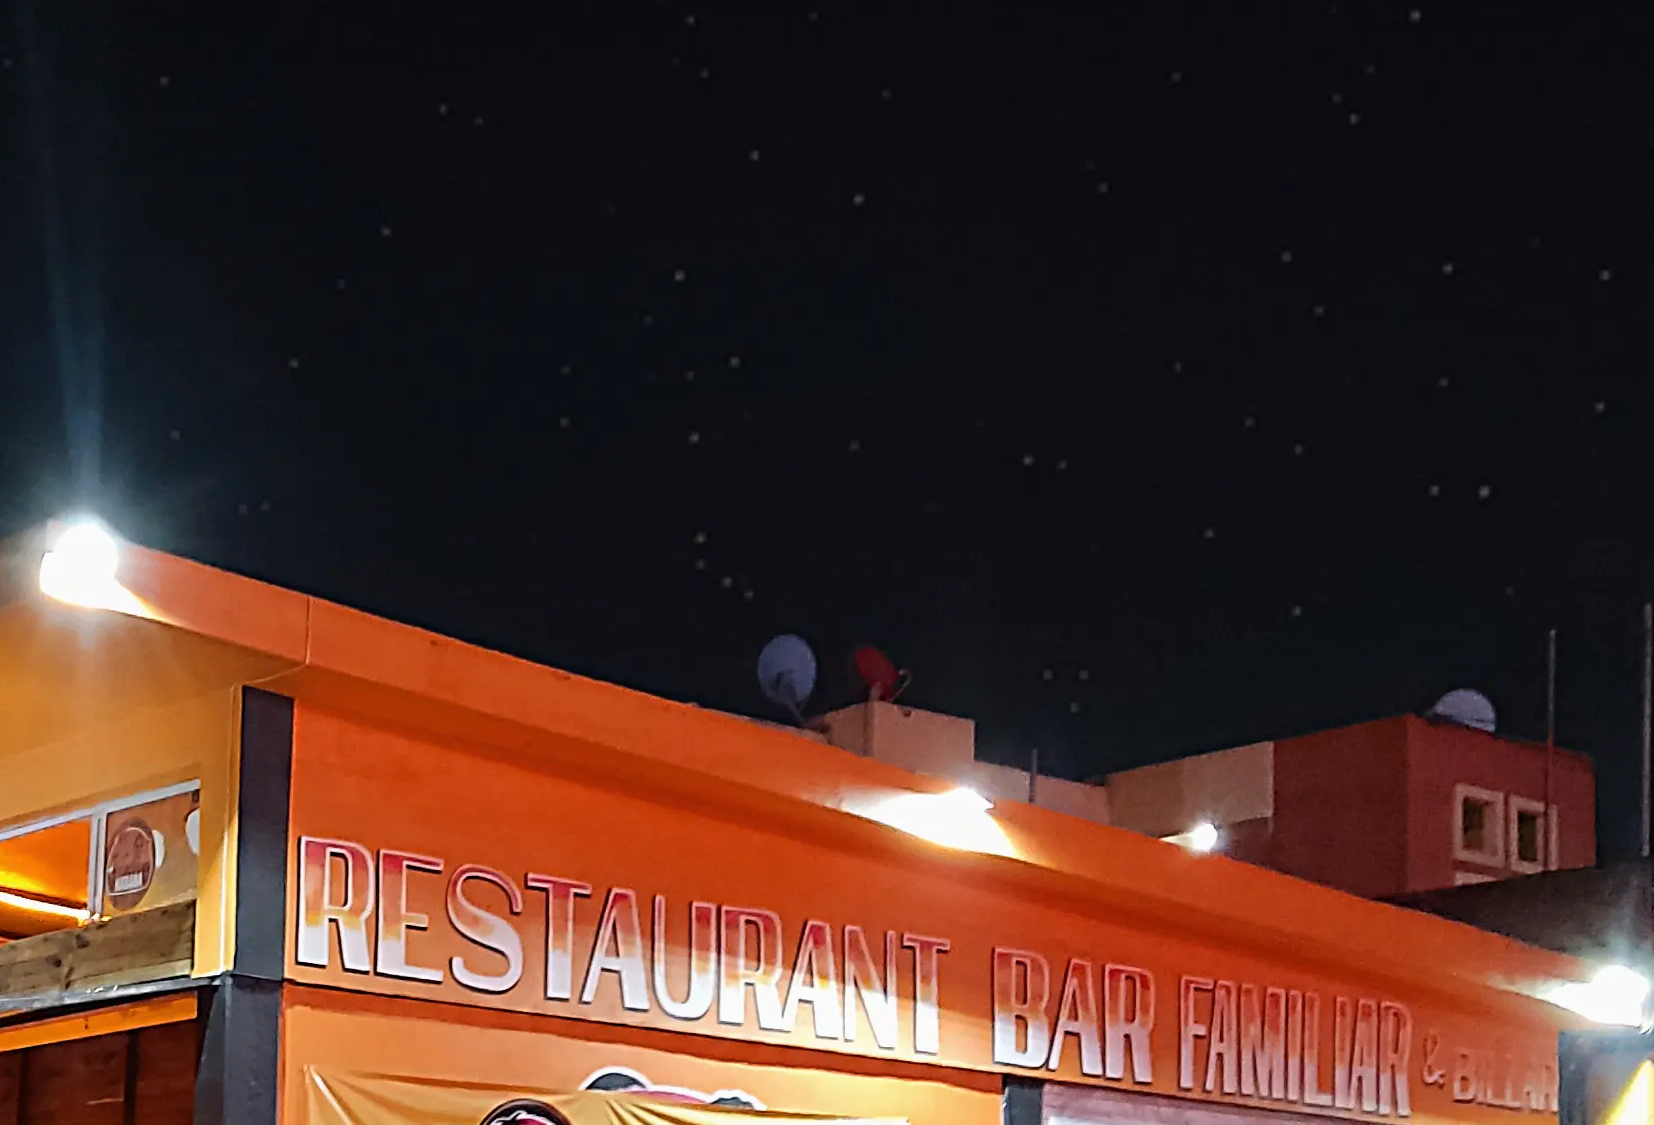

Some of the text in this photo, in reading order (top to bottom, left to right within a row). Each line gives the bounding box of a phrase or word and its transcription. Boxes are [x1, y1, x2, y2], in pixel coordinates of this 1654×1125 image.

[297, 836, 950, 1054] RESTAURANT
[993, 945, 1156, 1084] BAR
[1178, 975, 1413, 1117] FAMILIAR
[1422, 1030, 1446, 1089] &
